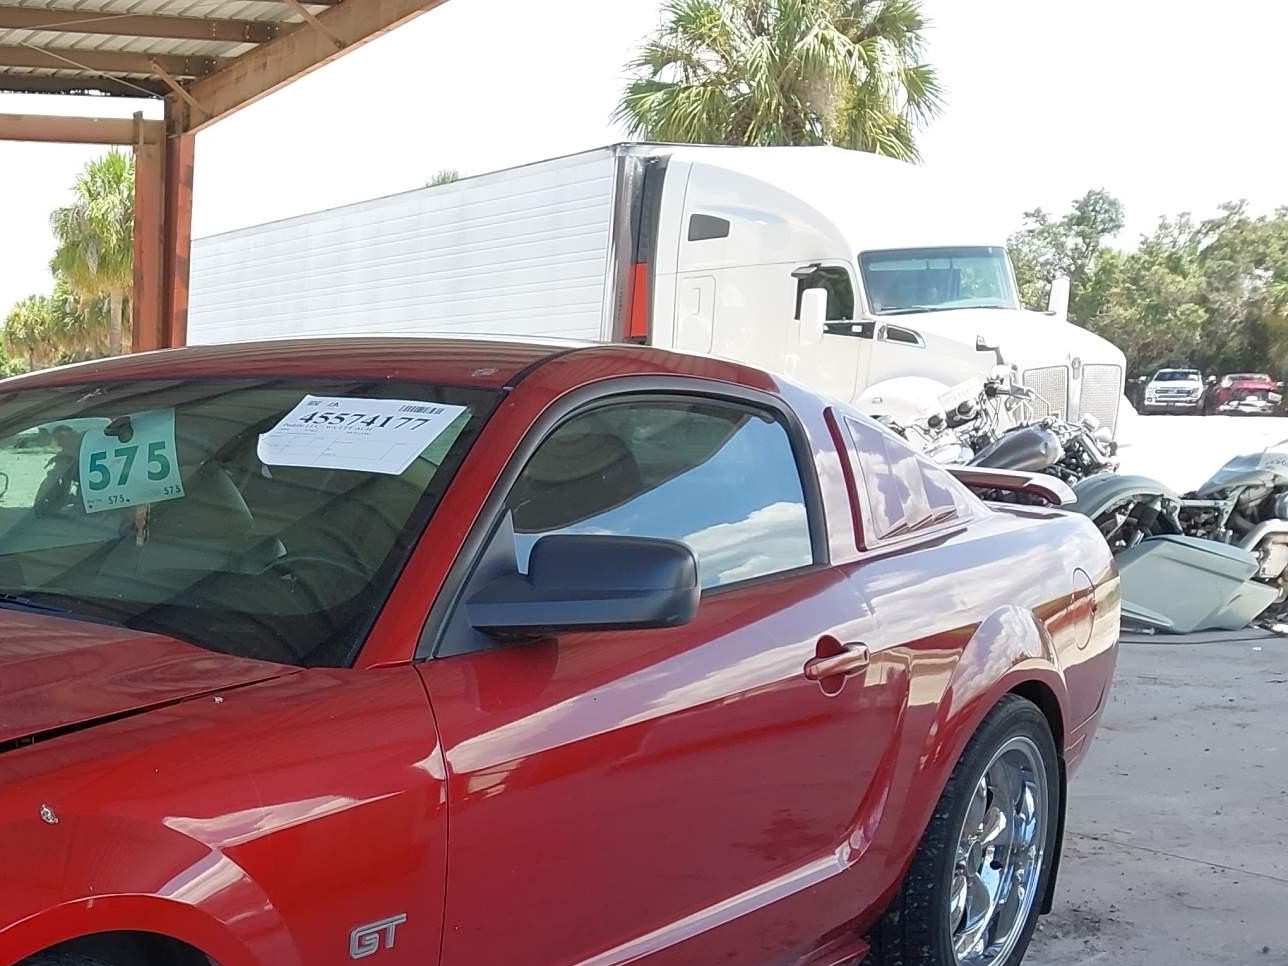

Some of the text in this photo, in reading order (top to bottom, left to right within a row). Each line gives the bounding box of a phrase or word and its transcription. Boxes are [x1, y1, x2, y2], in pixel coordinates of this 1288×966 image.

[299, 411, 431, 431] 45574177
[88, 441, 171, 491] 575
[163, 485, 181, 496] 575
[350, 913, 407, 960] GT
